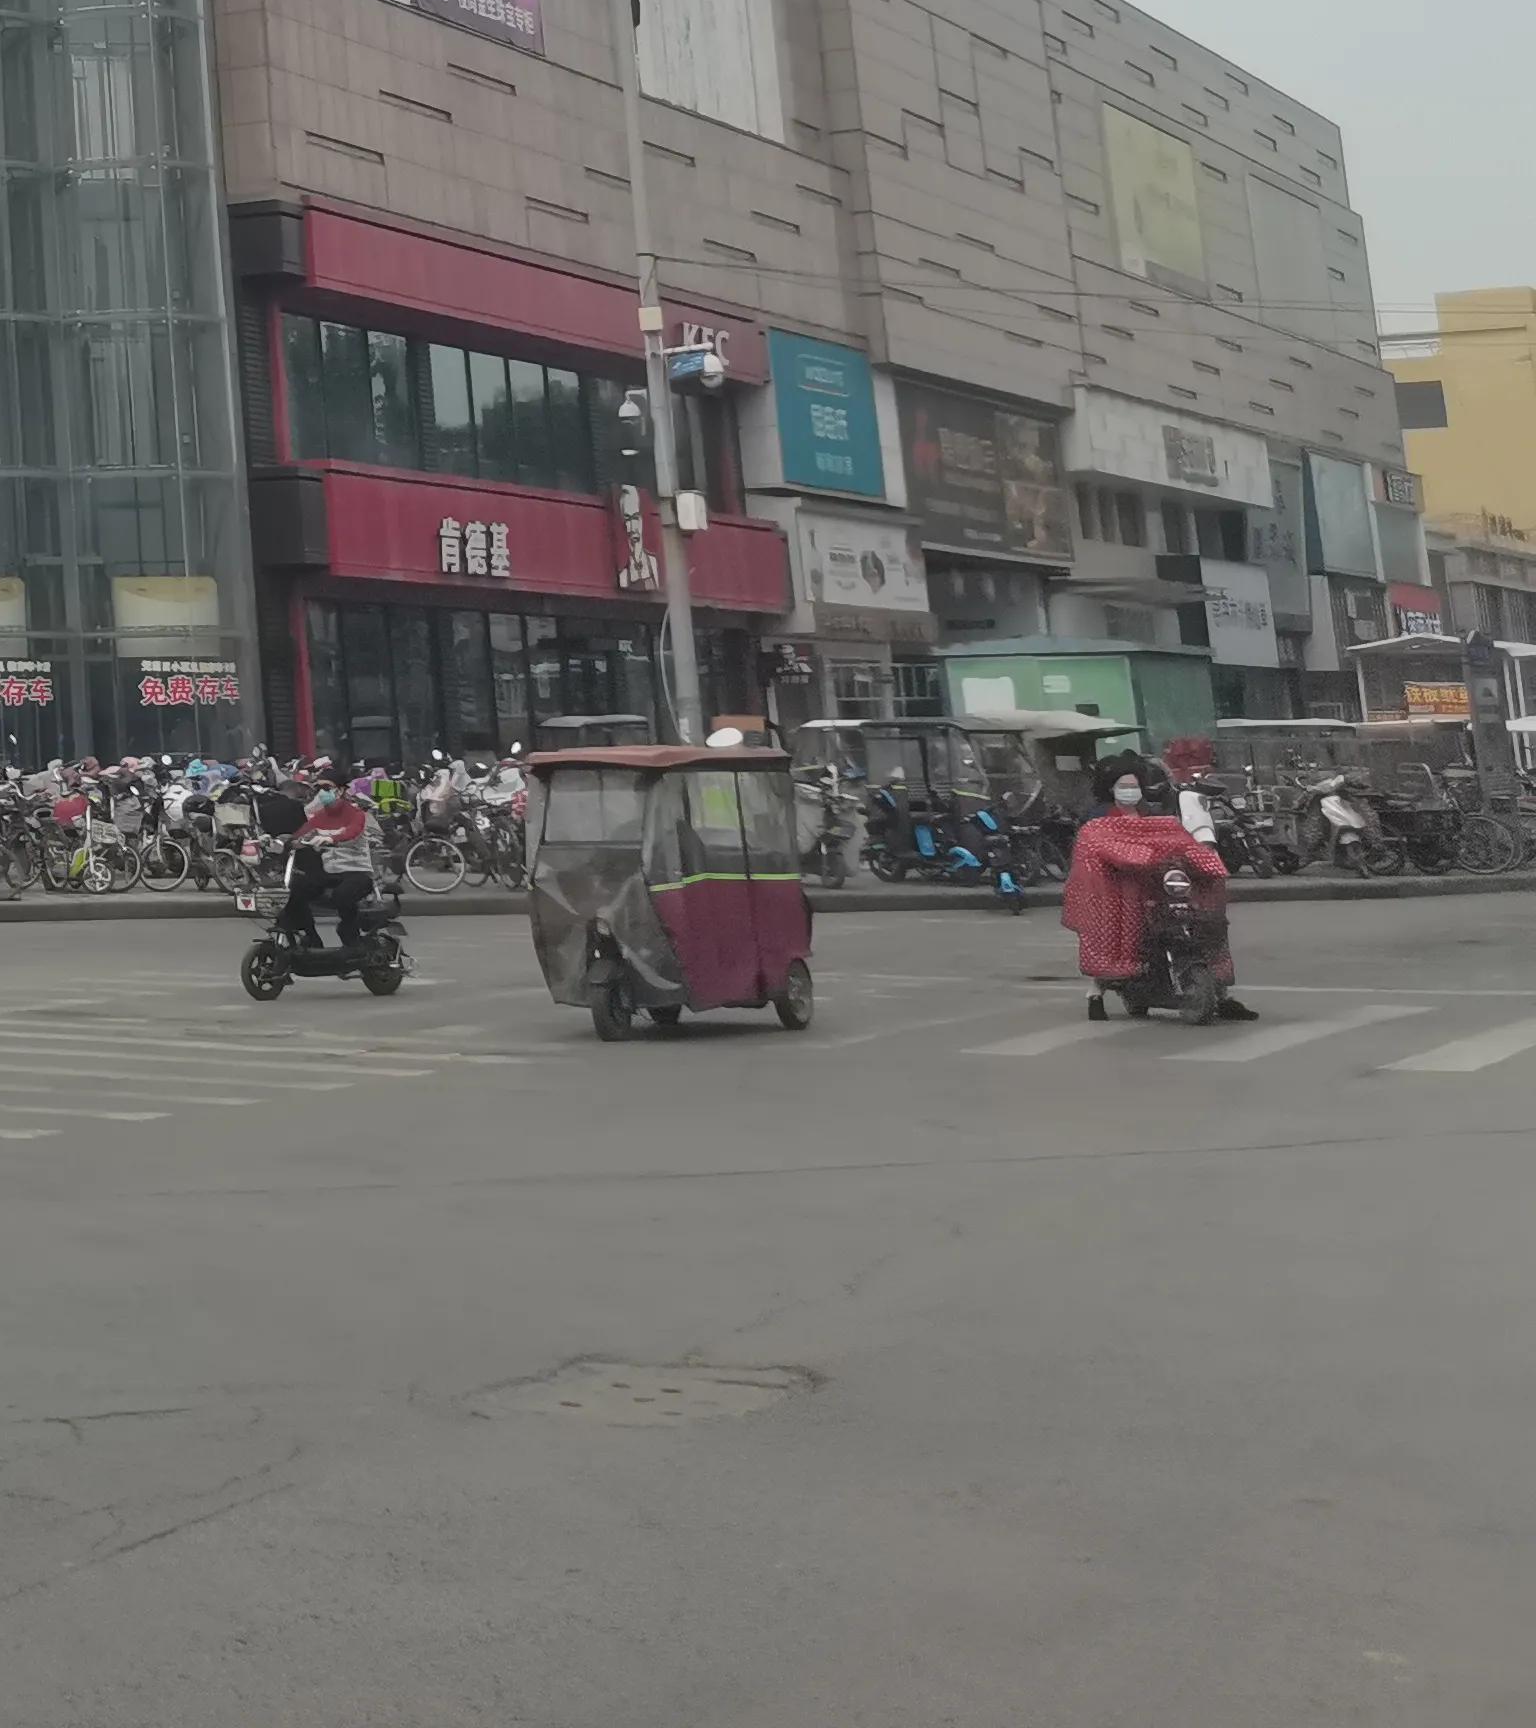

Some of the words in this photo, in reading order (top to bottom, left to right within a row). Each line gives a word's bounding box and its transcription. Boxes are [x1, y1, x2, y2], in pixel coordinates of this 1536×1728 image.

[682, 322, 730, 365] KFC
[439, 516, 511, 578] 肯德基
[138, 675, 241, 706] 免费存车
